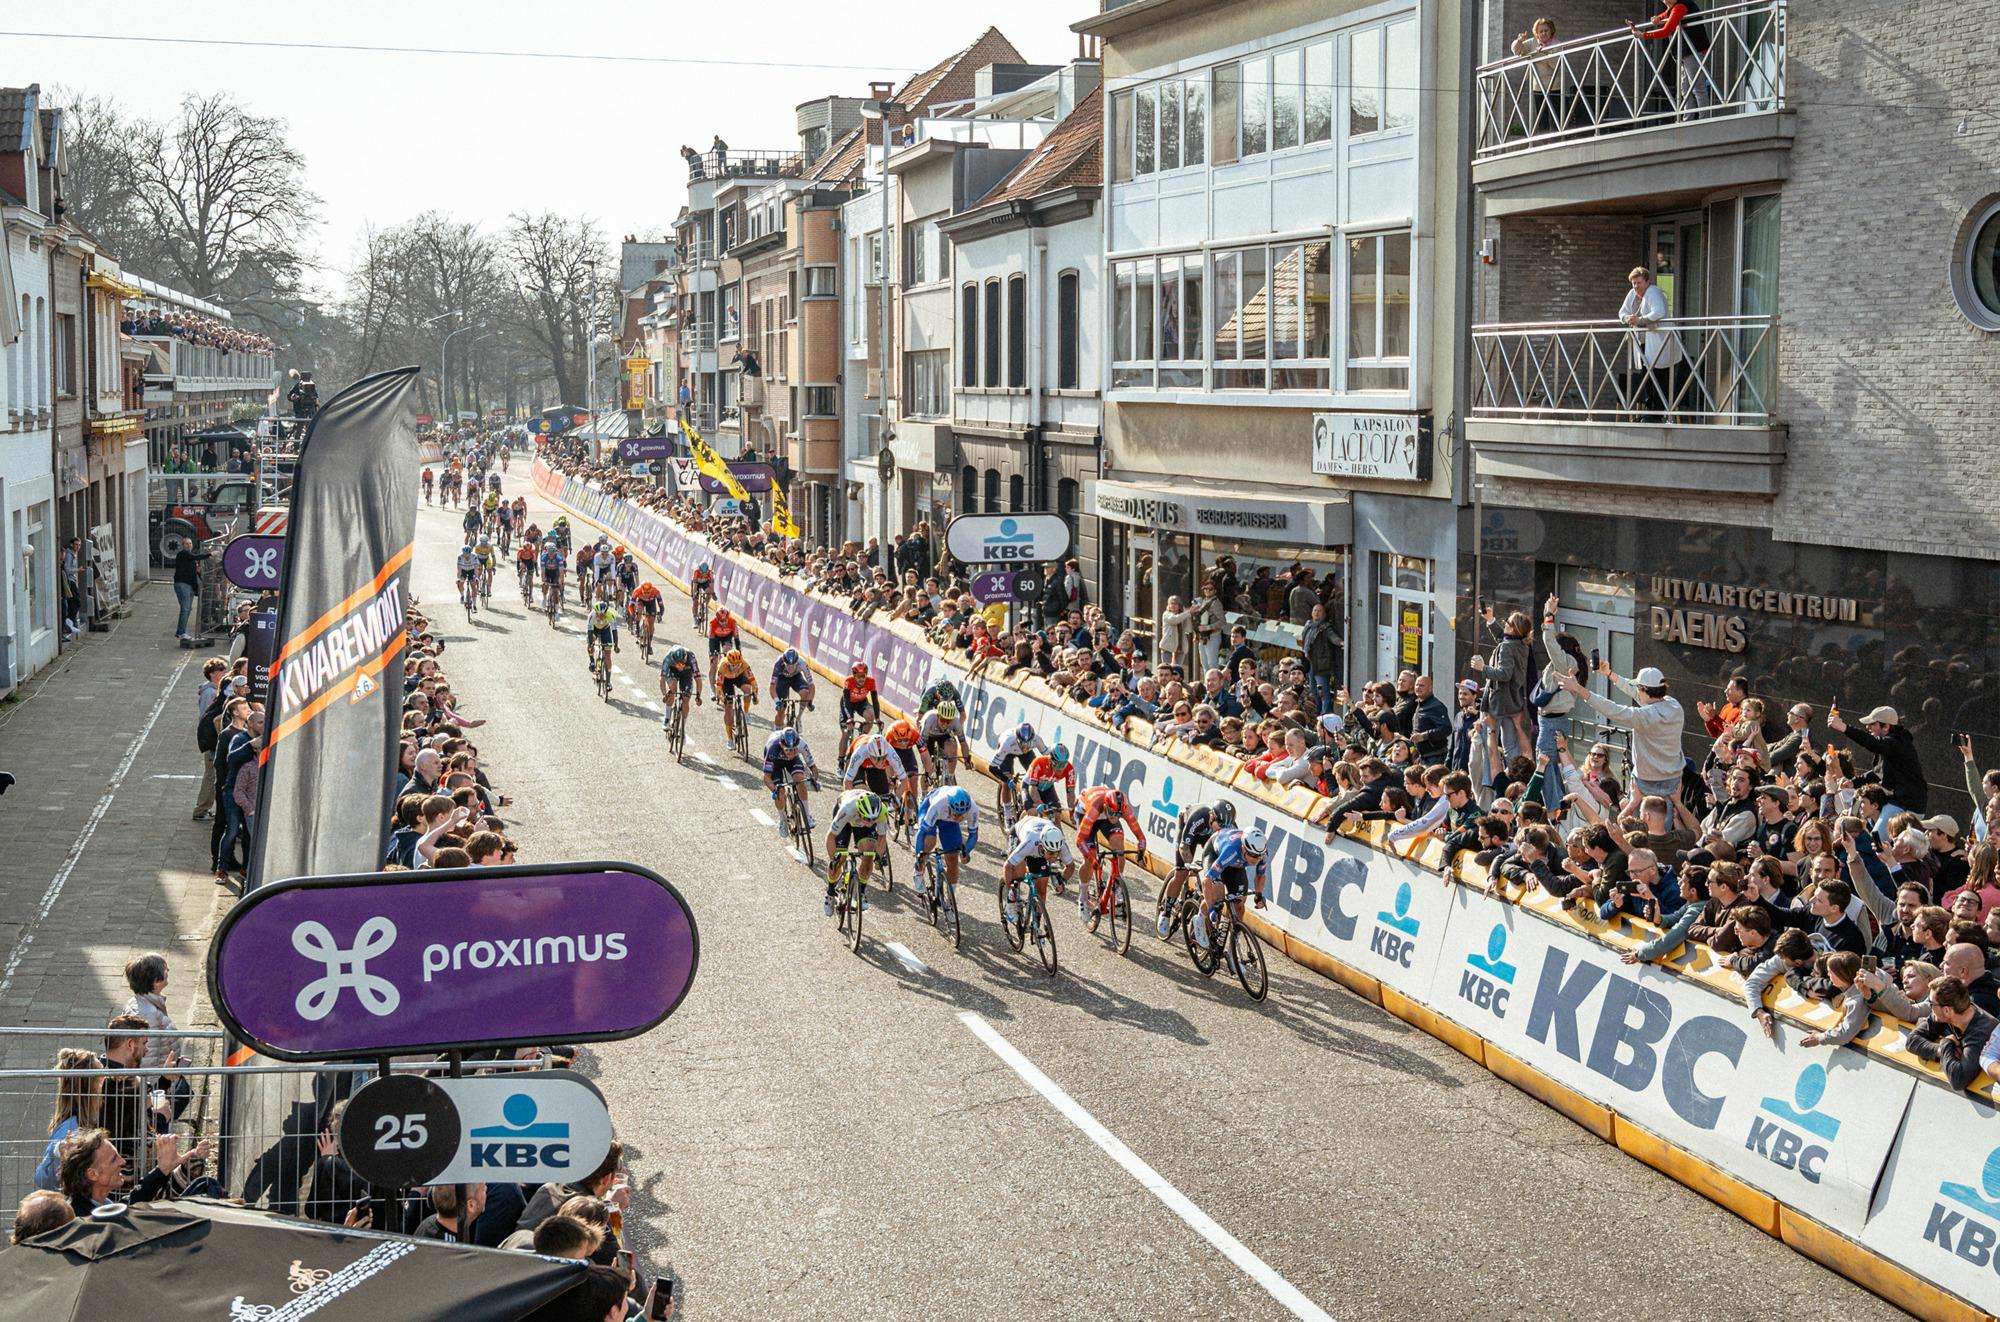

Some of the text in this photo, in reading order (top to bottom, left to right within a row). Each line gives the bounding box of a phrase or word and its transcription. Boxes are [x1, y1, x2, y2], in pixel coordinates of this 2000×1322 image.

[1354, 418, 1412, 432] KAPSALON
[1331, 432, 1398, 464] LACROIX
[1317, 461, 1342, 472] DAMES
[1351, 463, 1379, 475] HEREN
[1128, 499, 1180, 525] DAEMS
[1197, 508, 1288, 529] BEGRAFENISSEN
[984, 544, 1034, 559] KBC
[984, 592, 1012, 600] proximus
[1020, 580, 1035, 591] 50
[1651, 576, 1857, 622] UITVAARTCENTRUM
[280, 578, 403, 713] KWAREMONT
[1651, 606, 1746, 653] DAEMS
[1148, 812, 1177, 843] KBC
[423, 932, 628, 982] proximus
[1370, 926, 1415, 969] KBC
[1459, 970, 1510, 1018] KBC
[1525, 945, 1747, 1130] KBC
[374, 1113, 428, 1150] 25
[470, 1143, 570, 1168] KBC
[1745, 1115, 1829, 1184] KBC
